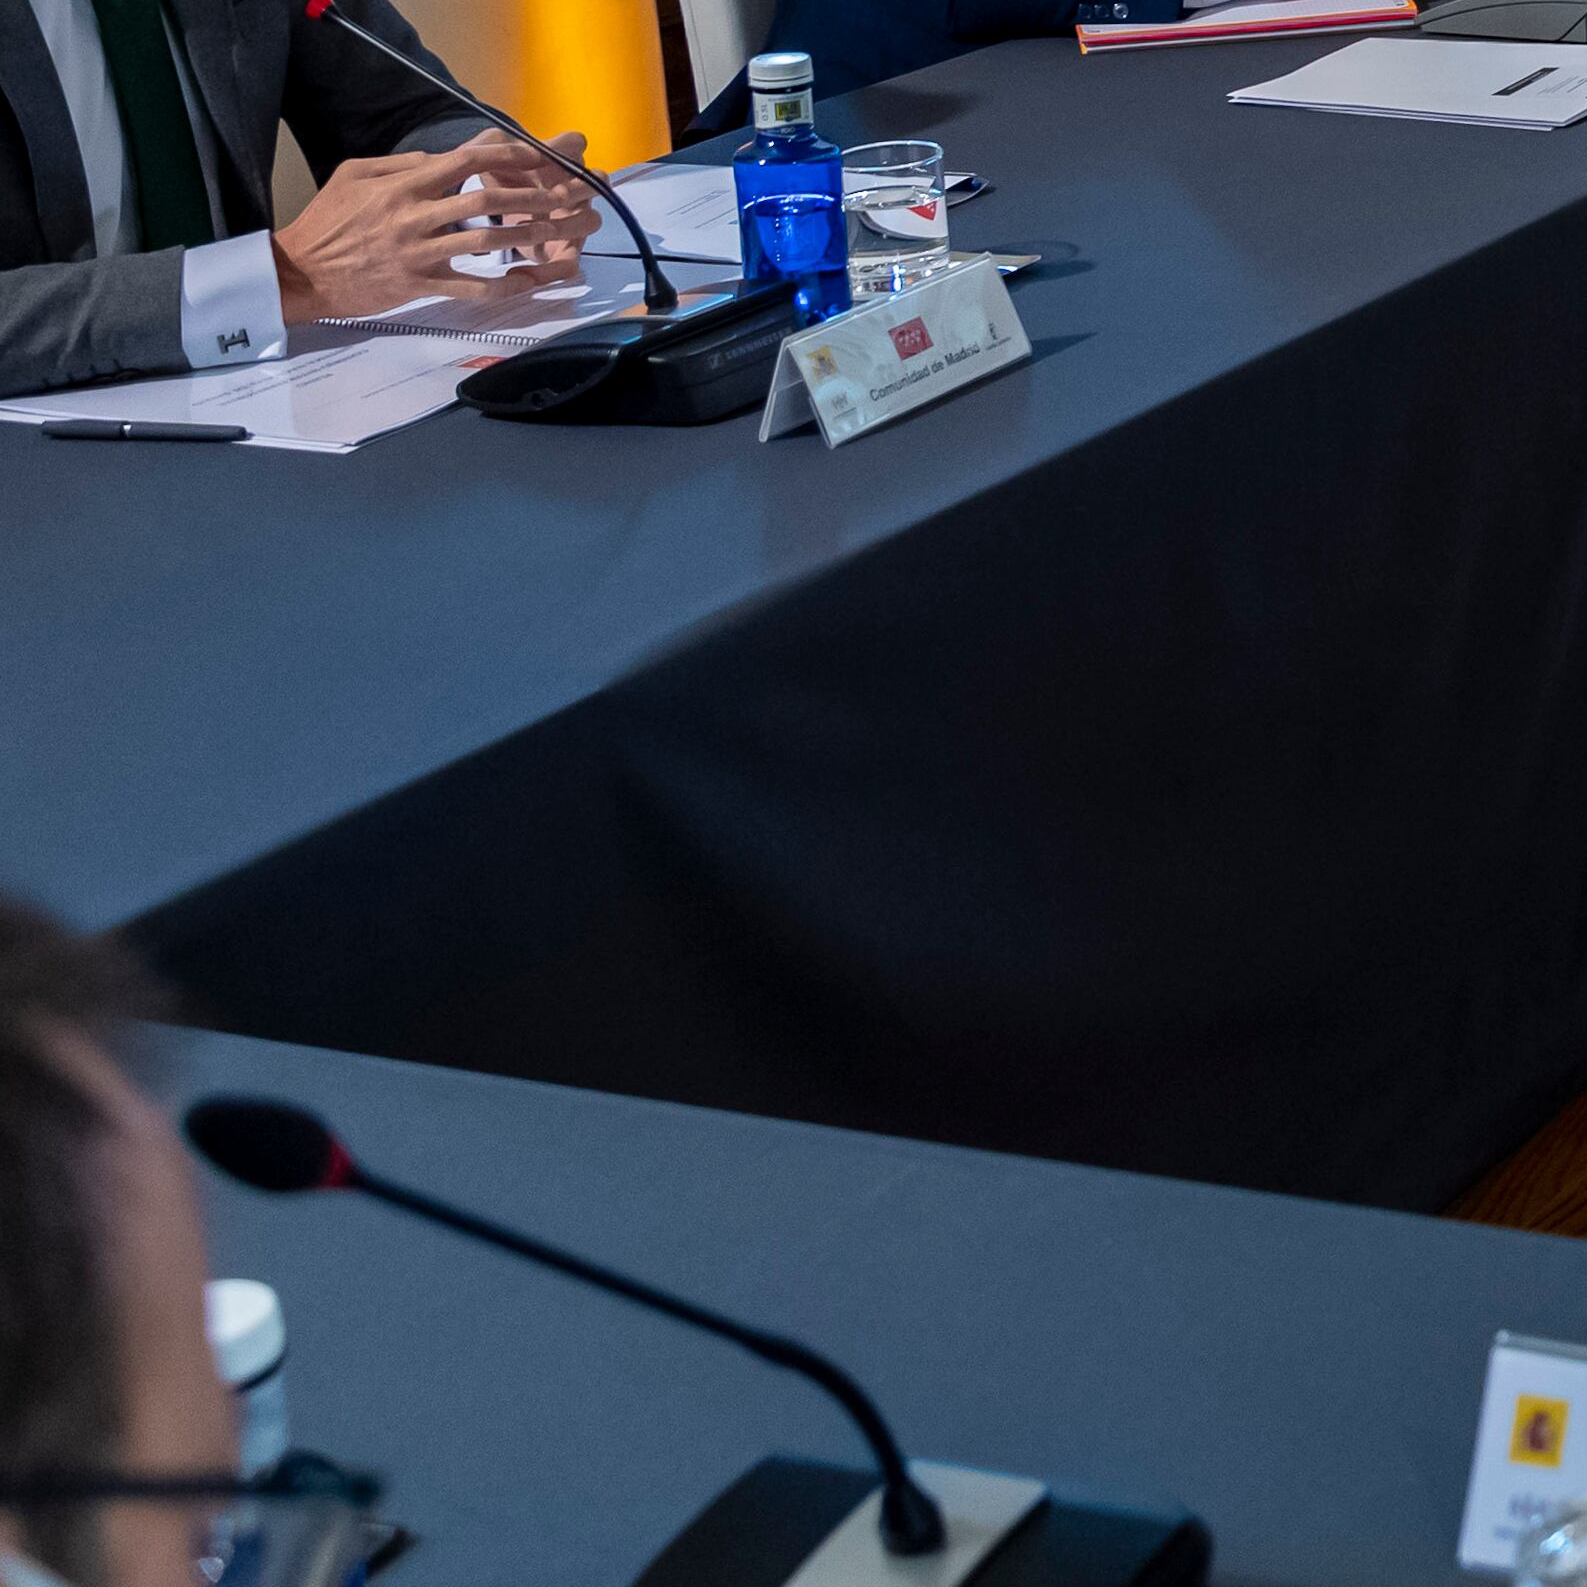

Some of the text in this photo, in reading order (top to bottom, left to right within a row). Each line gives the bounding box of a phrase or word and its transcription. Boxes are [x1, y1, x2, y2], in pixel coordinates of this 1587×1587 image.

[869, 364, 931, 402] Comunidad
[931, 360, 945, 374] de
[944, 342, 981, 366] Madrid
